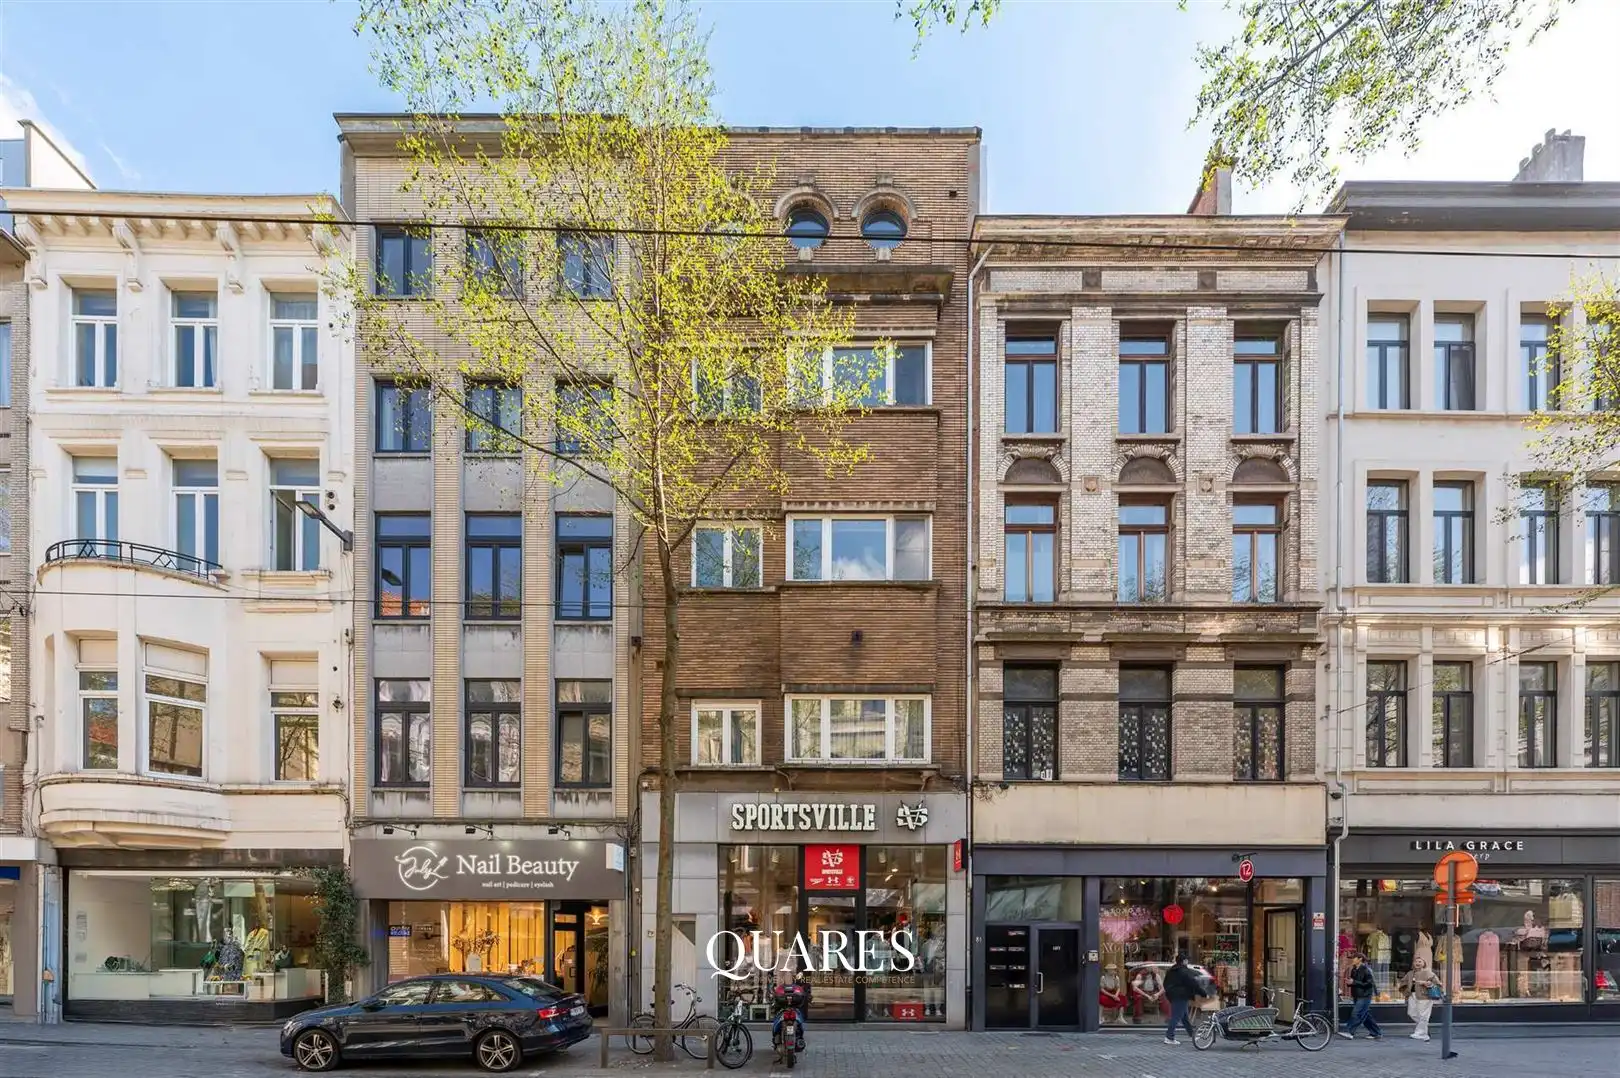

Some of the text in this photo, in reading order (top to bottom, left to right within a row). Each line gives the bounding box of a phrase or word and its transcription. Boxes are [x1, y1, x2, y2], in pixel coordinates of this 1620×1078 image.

[731, 803, 877, 831] SPORTSVILLE
[1415, 840, 1524, 850] LILA GRACE
[456, 853, 580, 881] Nail Beauty
[534, 881, 554, 889] eyelash
